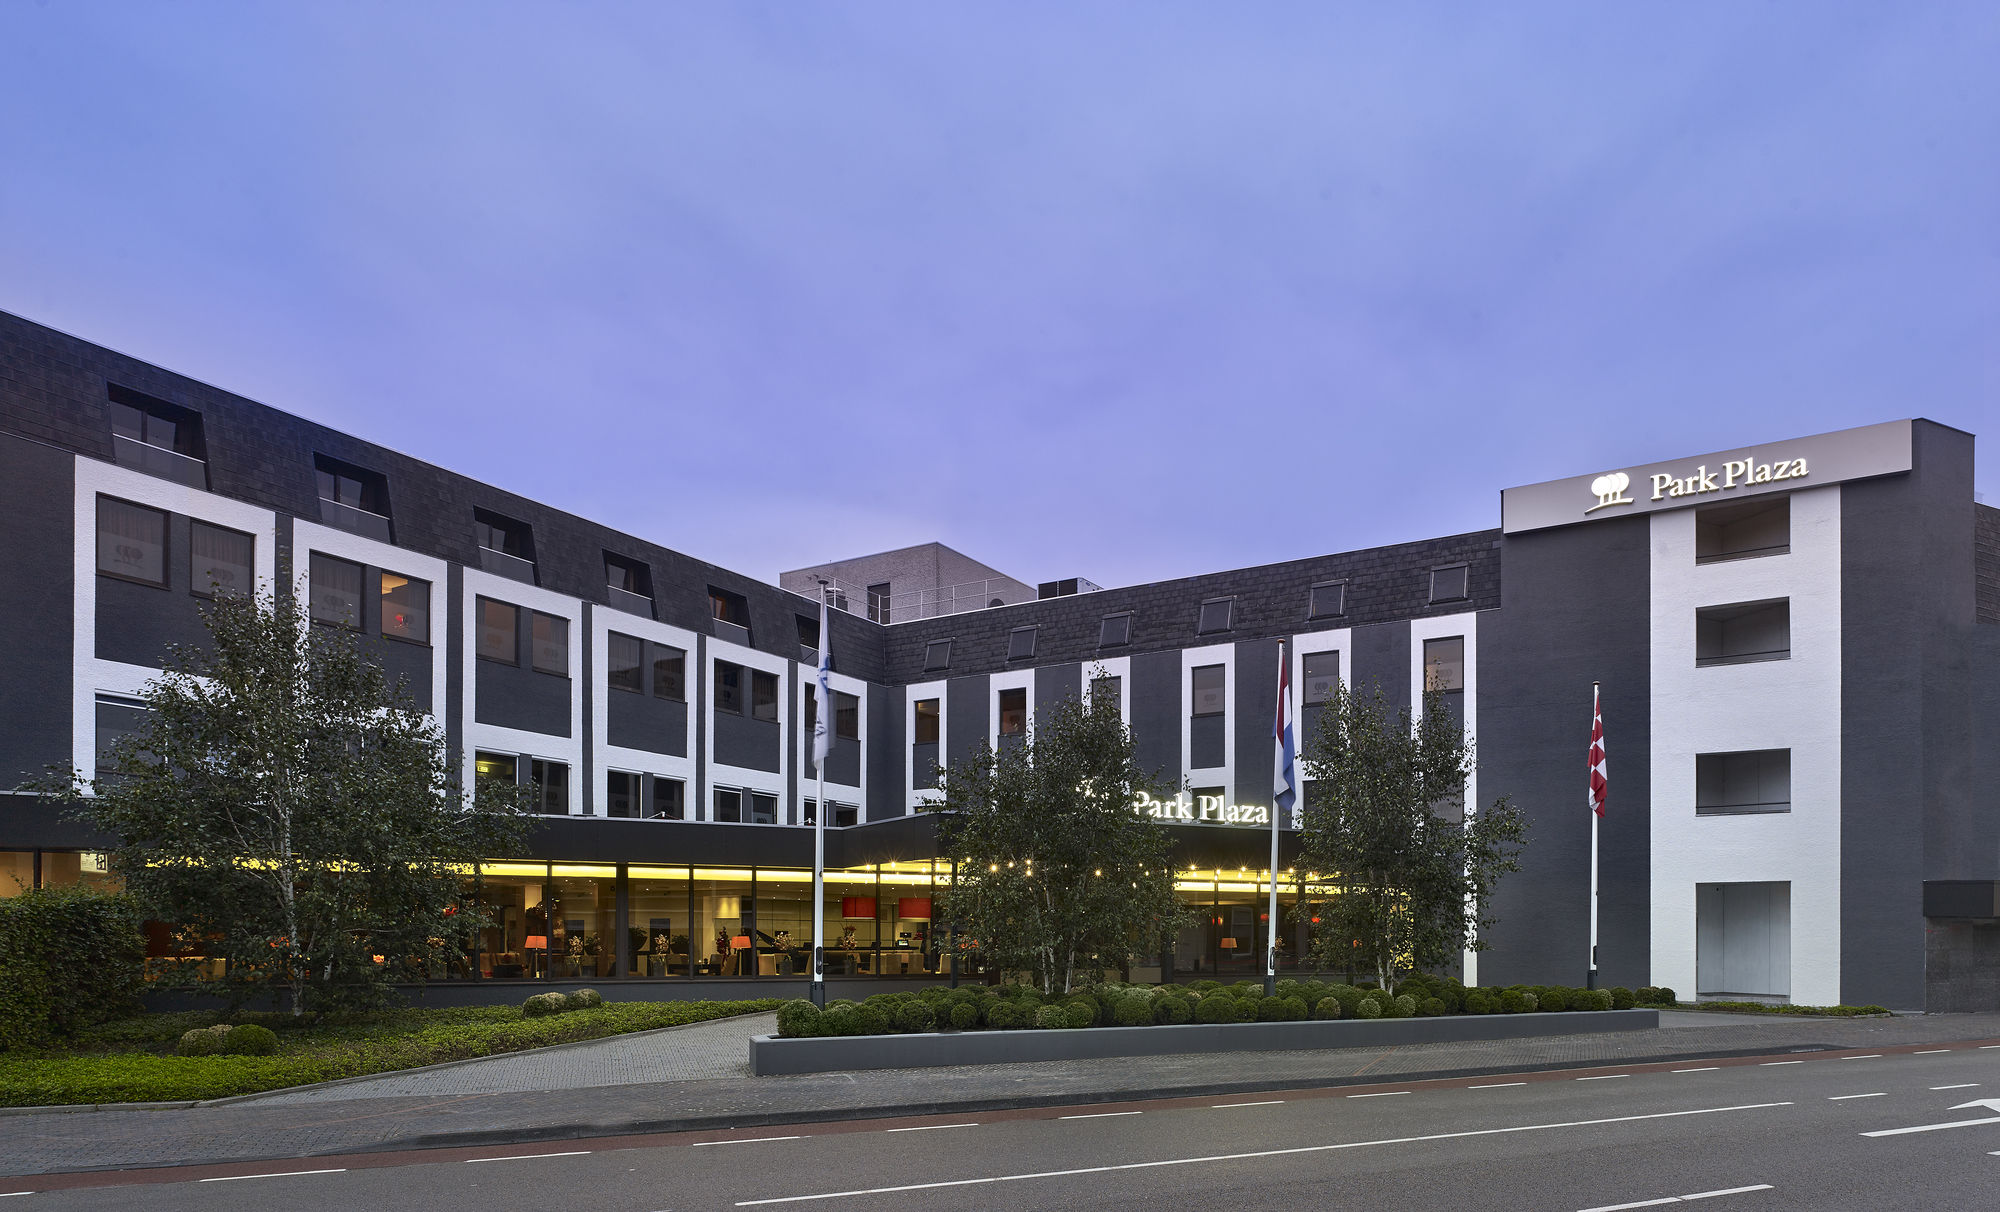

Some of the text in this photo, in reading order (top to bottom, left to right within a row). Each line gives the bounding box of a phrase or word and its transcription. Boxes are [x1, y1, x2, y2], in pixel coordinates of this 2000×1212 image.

[1650, 456, 1809, 501] Park Plaza
[1133, 790, 1269, 823] Park Plaza
